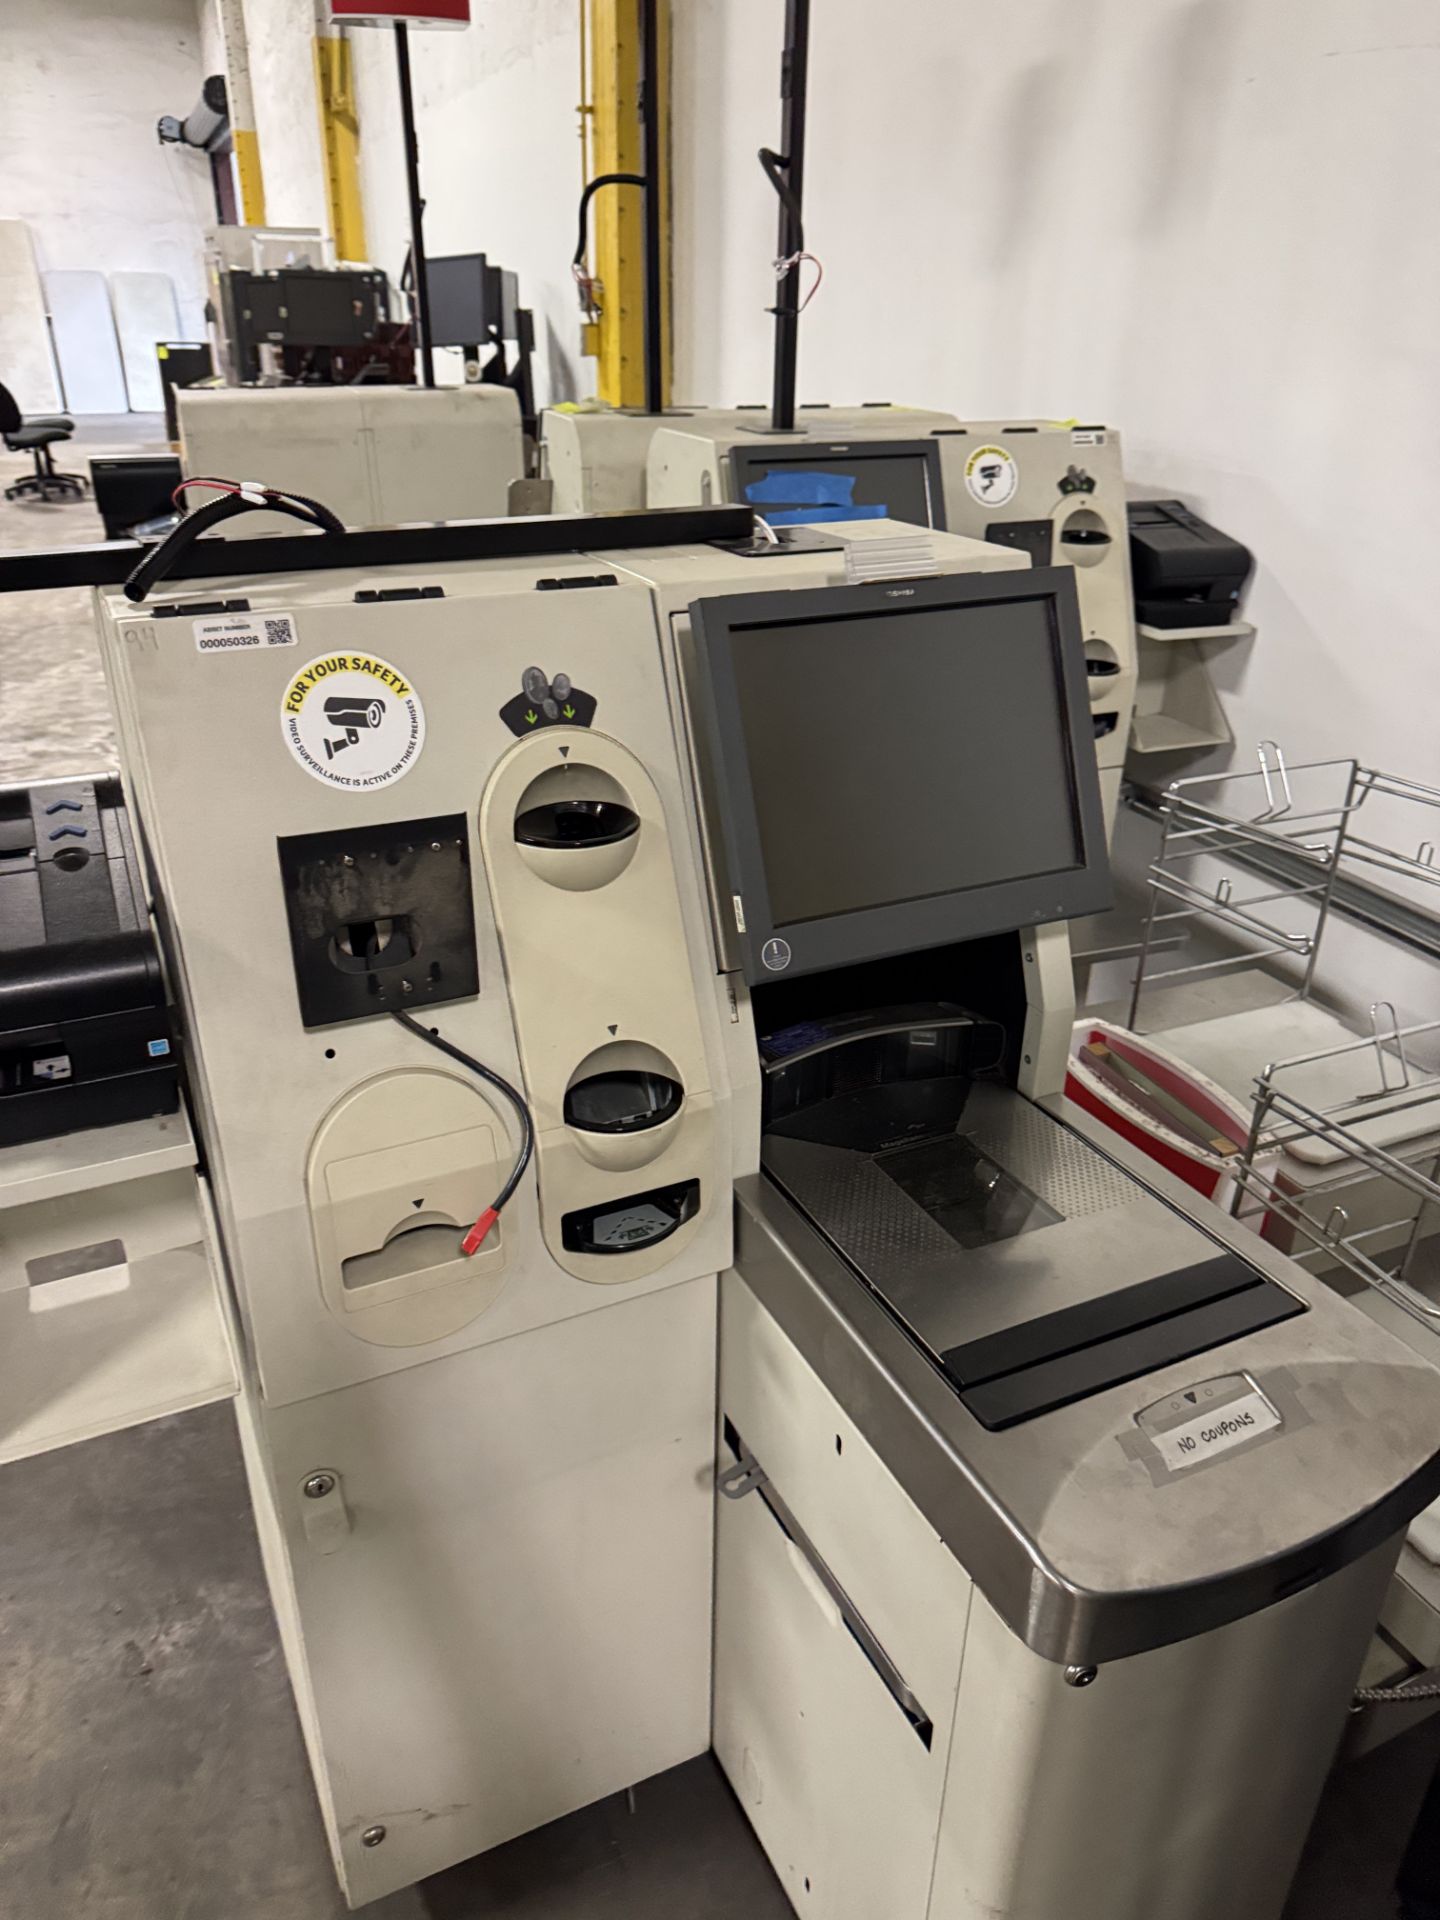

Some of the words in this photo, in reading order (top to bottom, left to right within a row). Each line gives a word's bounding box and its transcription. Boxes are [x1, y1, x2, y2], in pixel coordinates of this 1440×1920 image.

[200, 636, 260, 649] 000050326
[287, 681, 310, 713] FOR
[304, 657, 349, 683] YOUR
[351, 658, 409, 695] SAFETY
[288, 718, 301, 744] VIDEO
[405, 699, 418, 739] PREMISES
[400, 740, 417, 764] THESE
[296, 745, 351, 785] SURVEILLANCE
[392, 762, 403, 774] ON
[352, 778, 361, 786] IS
[362, 771, 392, 786] ACTIVE
[1177, 1436, 1196, 1454] NO
[1200, 1412, 1255, 1443] COUPONS
